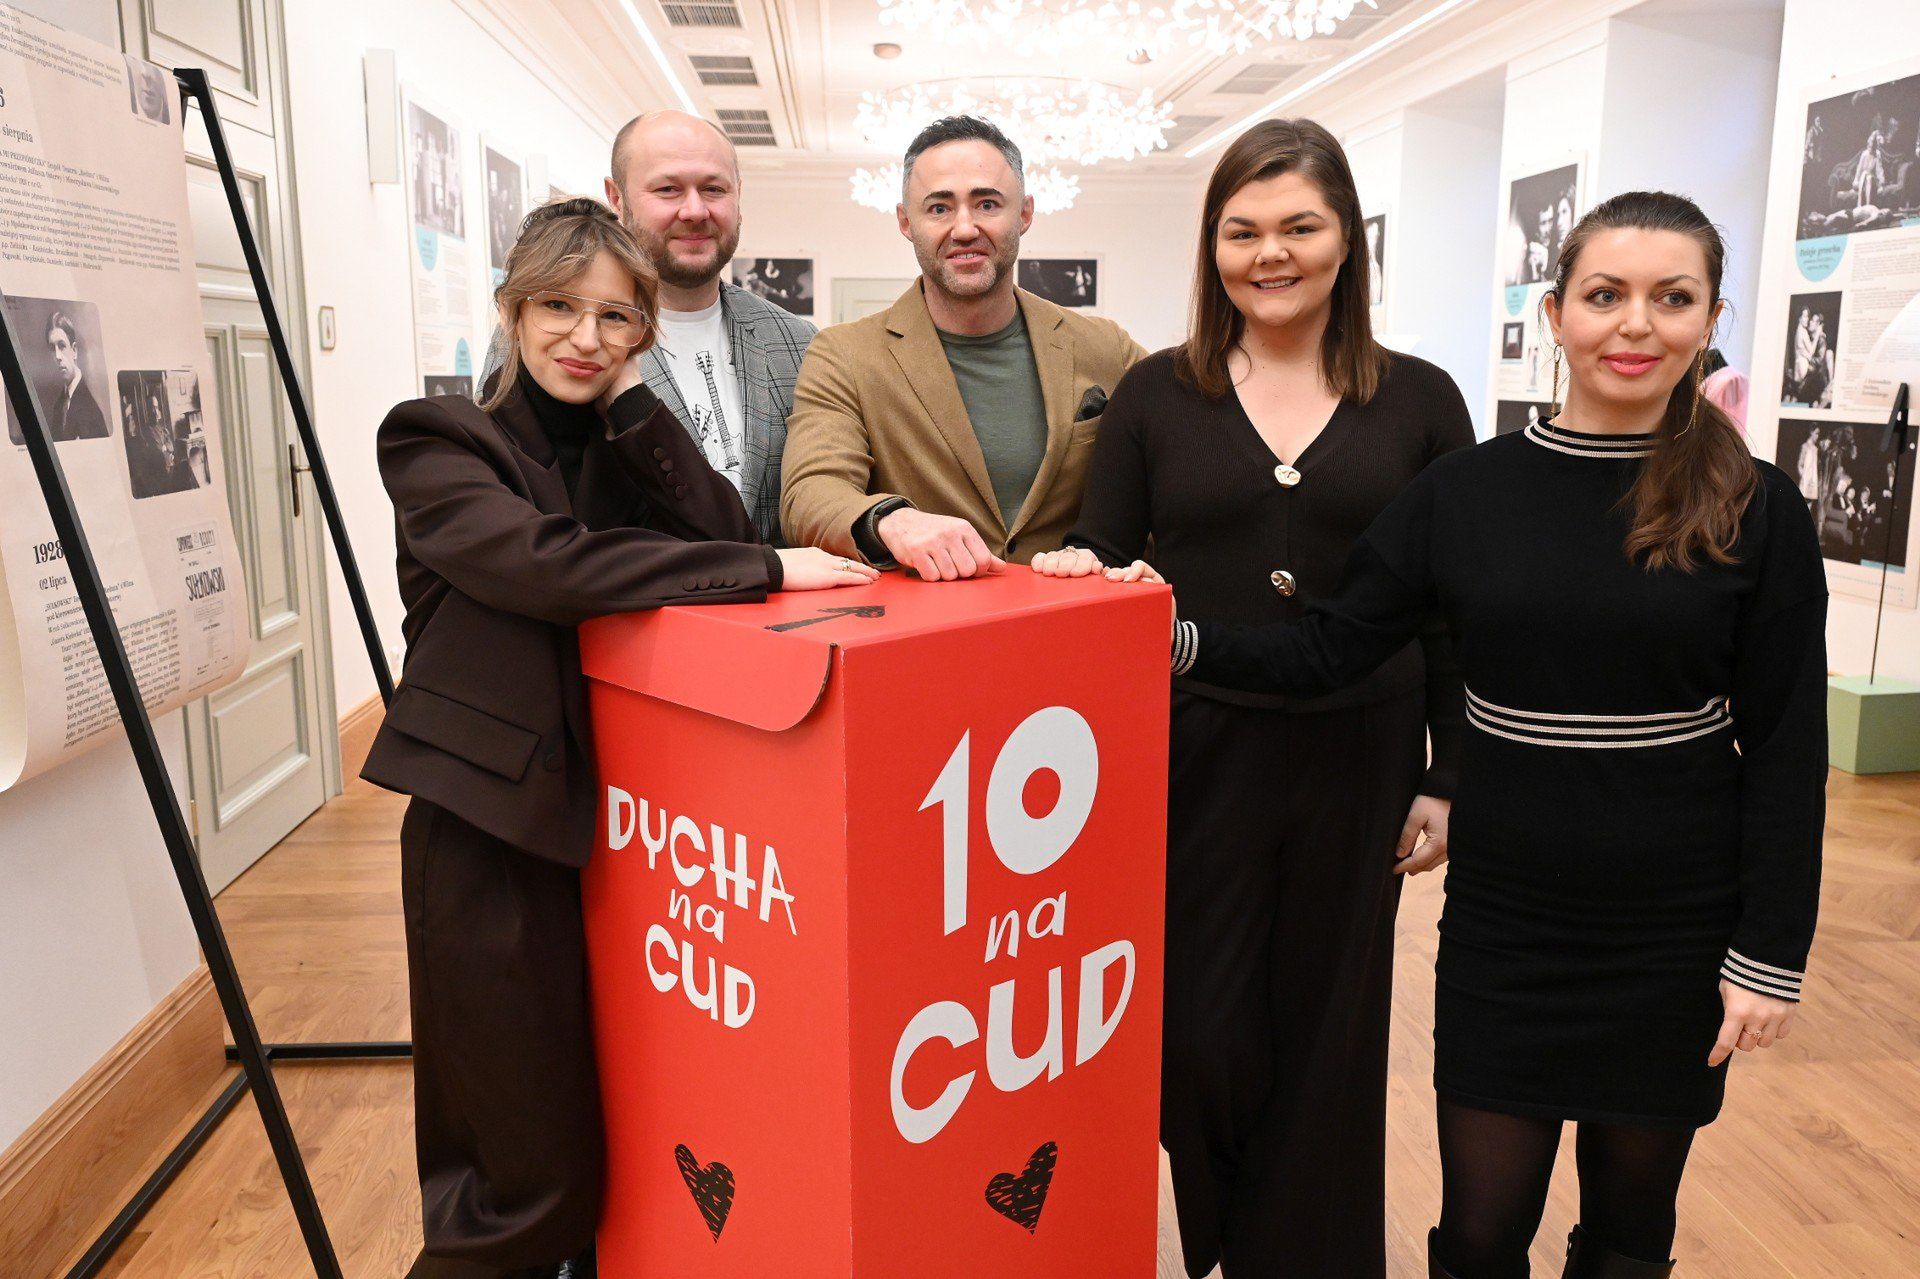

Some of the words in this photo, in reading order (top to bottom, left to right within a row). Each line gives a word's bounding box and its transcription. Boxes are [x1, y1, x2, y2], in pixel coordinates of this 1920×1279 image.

[2, 124, 34, 143] sierpnia
[32, 539, 64, 565] 1928
[39, 577, 49, 591] 02
[49, 575, 68, 591] lipca
[917, 706, 1099, 936] 10
[608, 784, 798, 936] DYCHA
[668, 887, 725, 944] na
[984, 890, 1068, 963] na
[645, 924, 756, 1029] CUD
[890, 939, 1136, 1145] CUD
